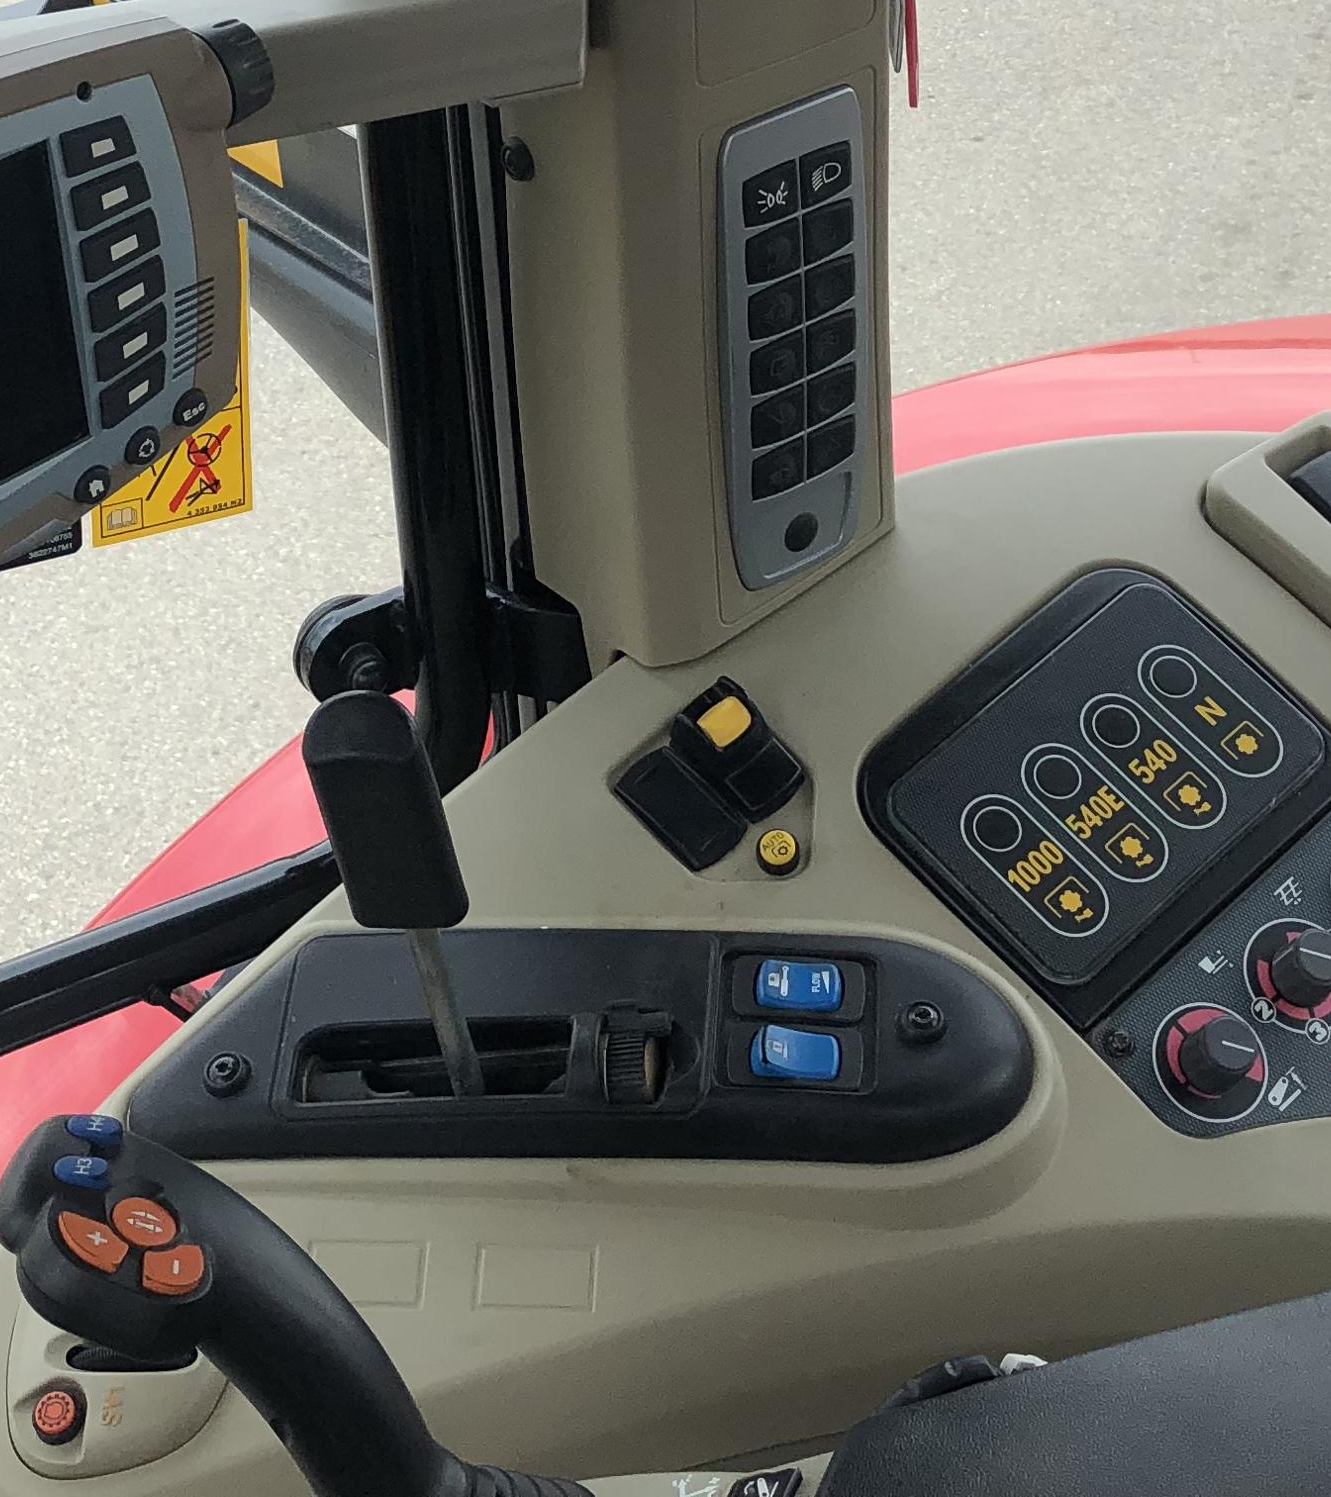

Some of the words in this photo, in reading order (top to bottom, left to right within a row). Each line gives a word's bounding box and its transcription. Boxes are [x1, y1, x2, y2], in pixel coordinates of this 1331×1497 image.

[181, 401, 206, 422] Esc
[1193, 695, 1228, 727] N
[1127, 738, 1178, 784] 540
[1064, 784, 1125, 840] 540E
[762, 831, 784, 852] AUTO
[1007, 840, 1065, 893] 1000
[1253, 1000, 1274, 1021] 2
[1308, 1021, 1328, 1042] 3
[87, 1115, 106, 1132] H4
[73, 1156, 93, 1176] H3
